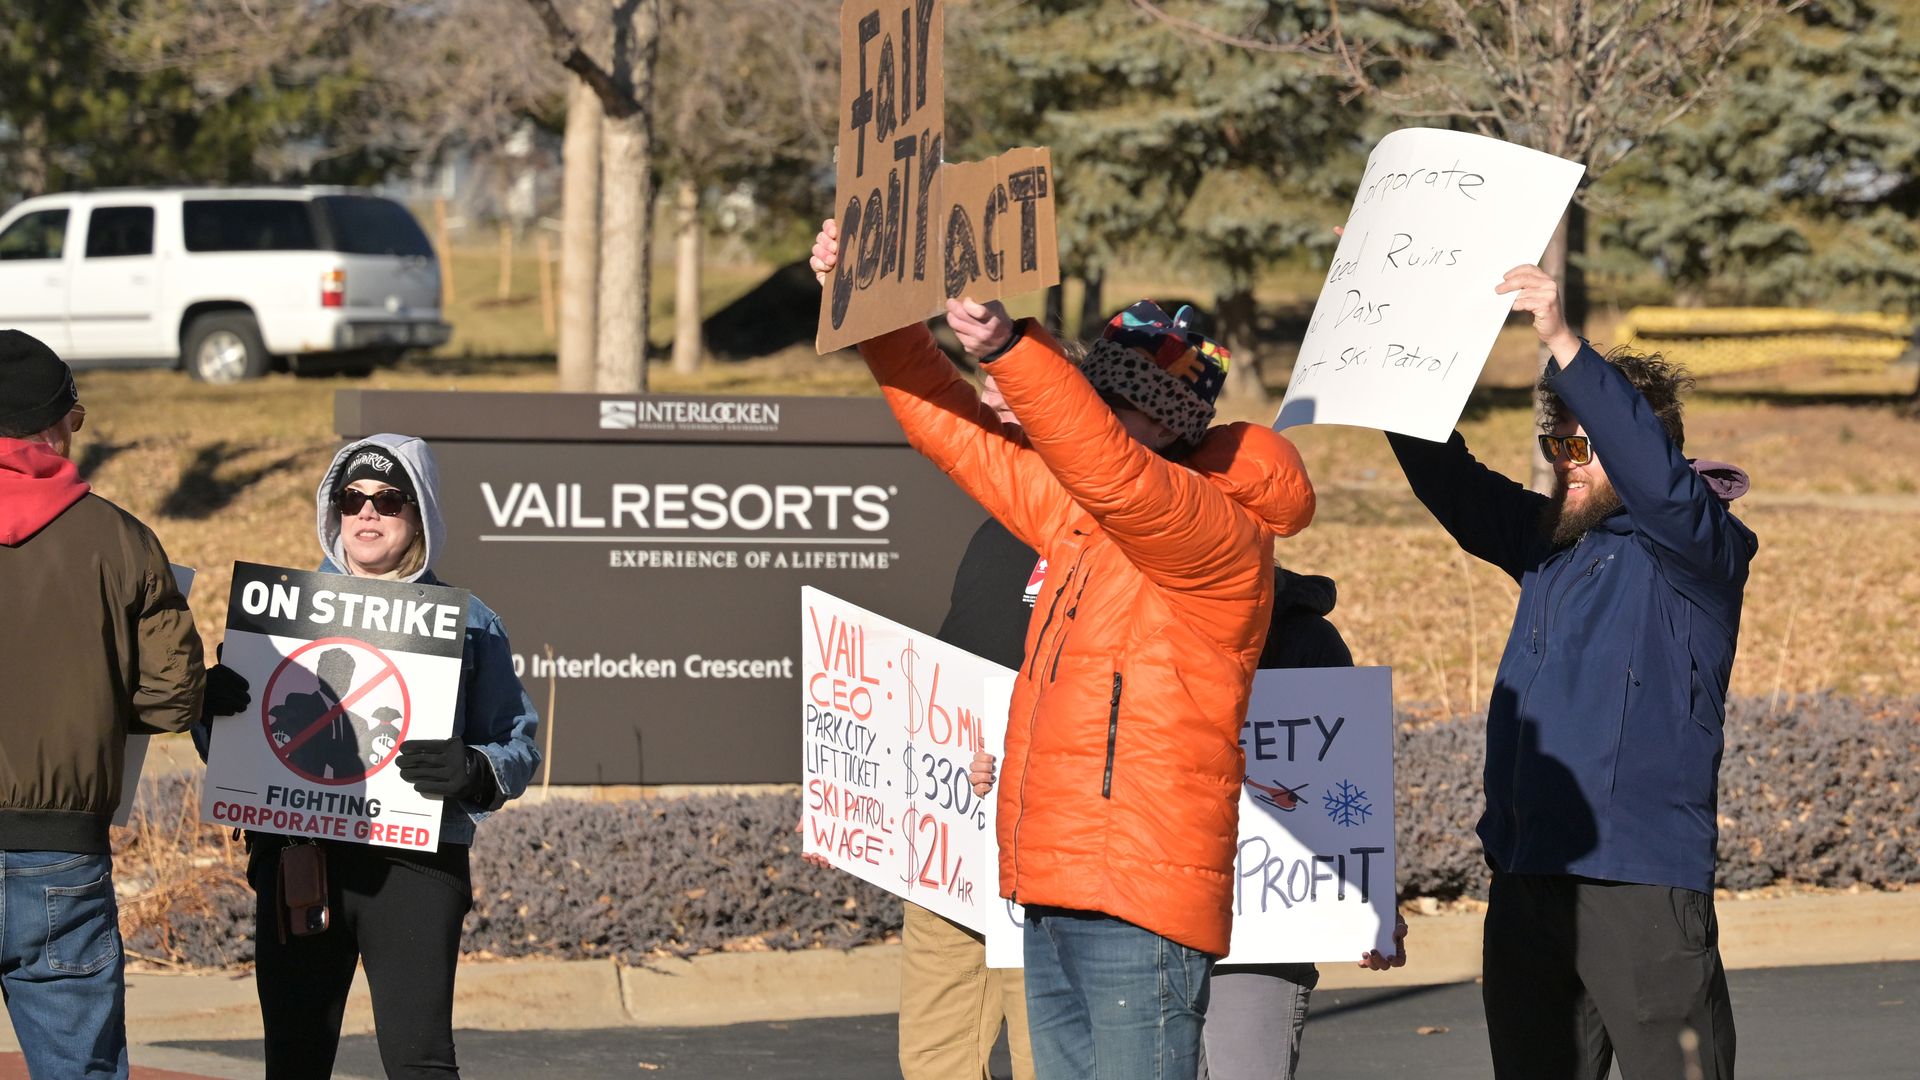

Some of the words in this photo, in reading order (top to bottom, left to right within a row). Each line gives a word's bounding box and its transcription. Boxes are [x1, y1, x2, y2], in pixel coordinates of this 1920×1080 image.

[1381, 232, 1462, 274] Ruins
[1381, 343, 1459, 381] Patrol
[638, 401, 780, 424] INTERLOCKEN
[480, 482, 605, 528] VAIL
[612, 483, 891, 531] RESORTS
[609, 550, 737, 568] EXPERIENCE
[745, 550, 772, 568] OF
[774, 551, 788, 568] A
[242, 580, 300, 621] ON
[309, 590, 461, 640] STRIKE
[532, 652, 676, 679] Interlocken
[684, 654, 793, 679] Crescent
[809, 606, 880, 685] VAIL
[809, 672, 873, 720] CEO
[901, 638, 952, 746] $6
[806, 704, 843, 746] PARK
[845, 719, 877, 756] CITY
[806, 740, 840, 779] LIFT
[841, 751, 880, 789] TICKET
[266, 785, 382, 818] FIGHTING
[809, 778, 840, 818] SKI
[212, 801, 349, 837] CORPORATE
[353, 821, 430, 847] GREED
[1236, 835, 1385, 916] PROFIT
